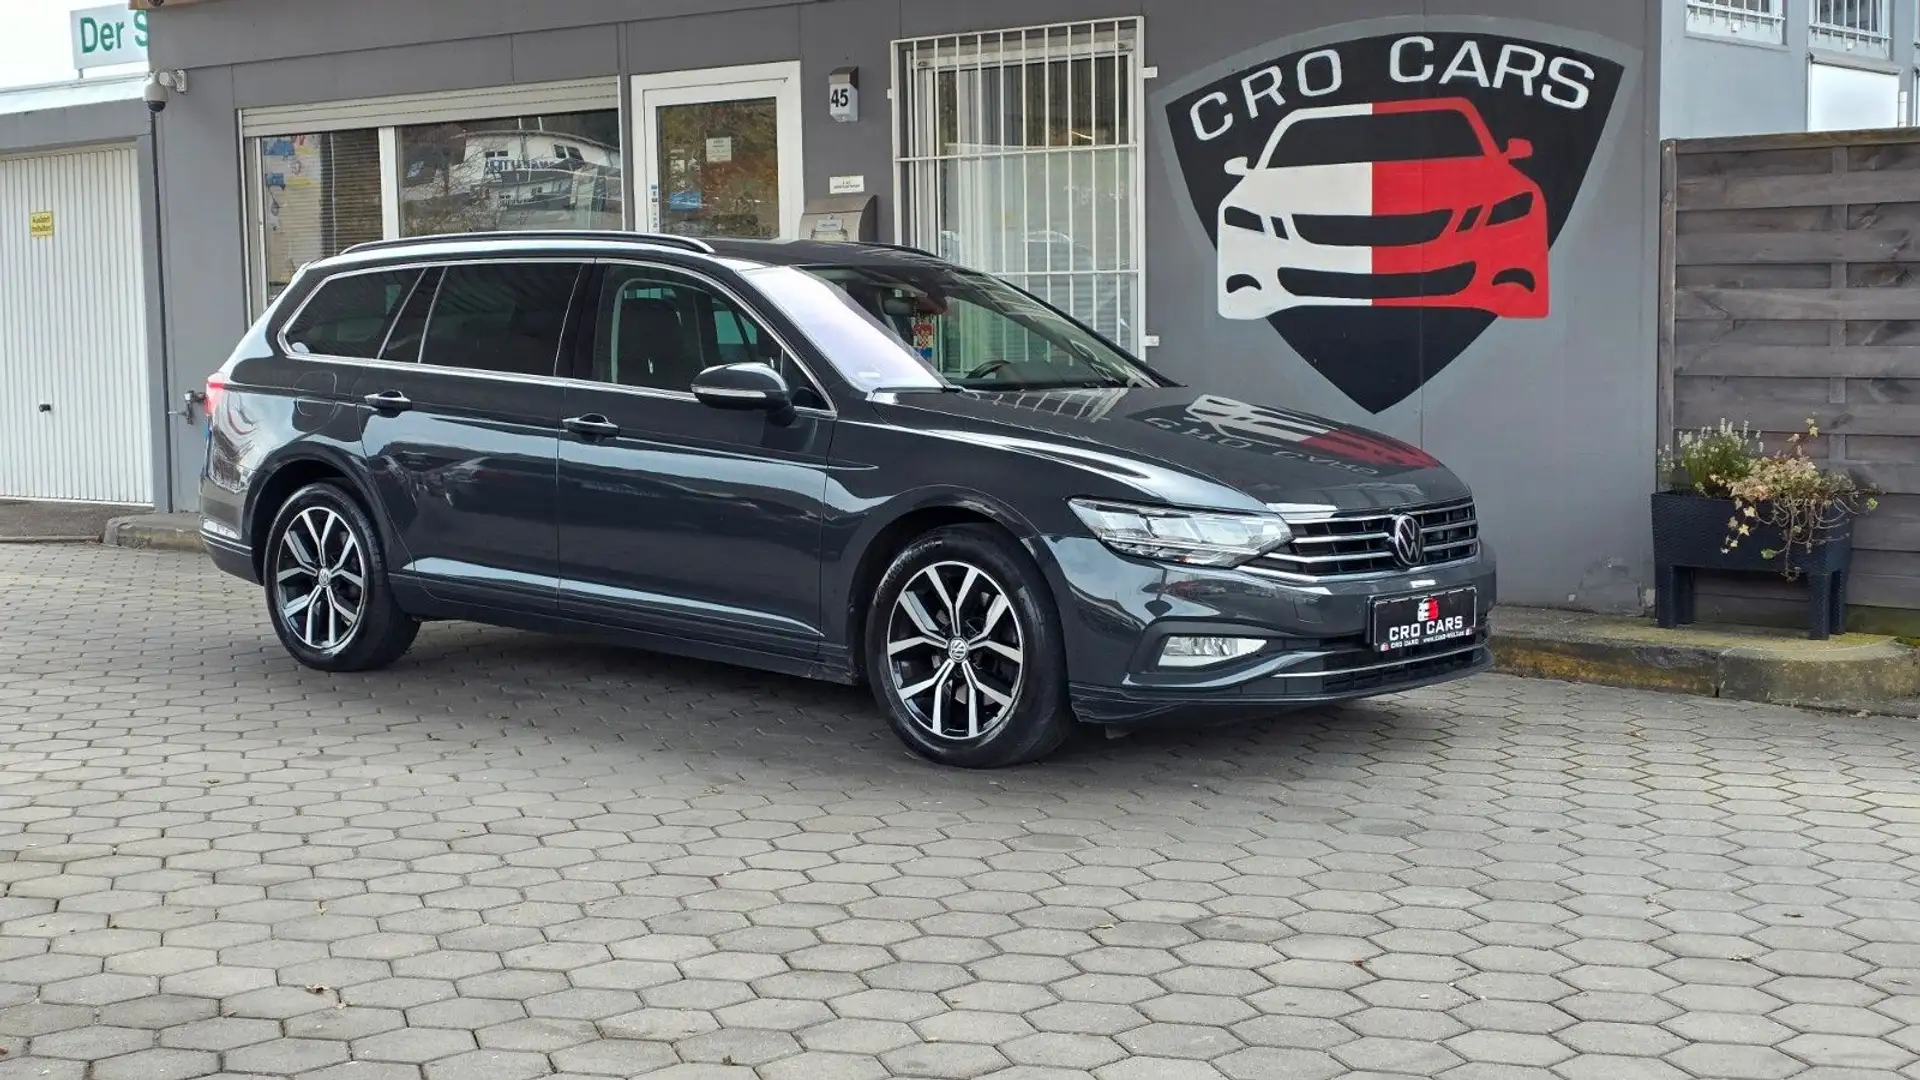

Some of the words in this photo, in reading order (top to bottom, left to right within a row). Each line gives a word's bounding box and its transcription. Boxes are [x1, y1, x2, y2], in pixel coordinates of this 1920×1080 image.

[80, 17, 124, 53] Der
[830, 88, 849, 108] 45
[1190, 49, 1342, 141] CRO
[1389, 36, 1595, 109] CARS
[1389, 622, 1421, 641] CRO
[1426, 615, 1463, 635] CARS
